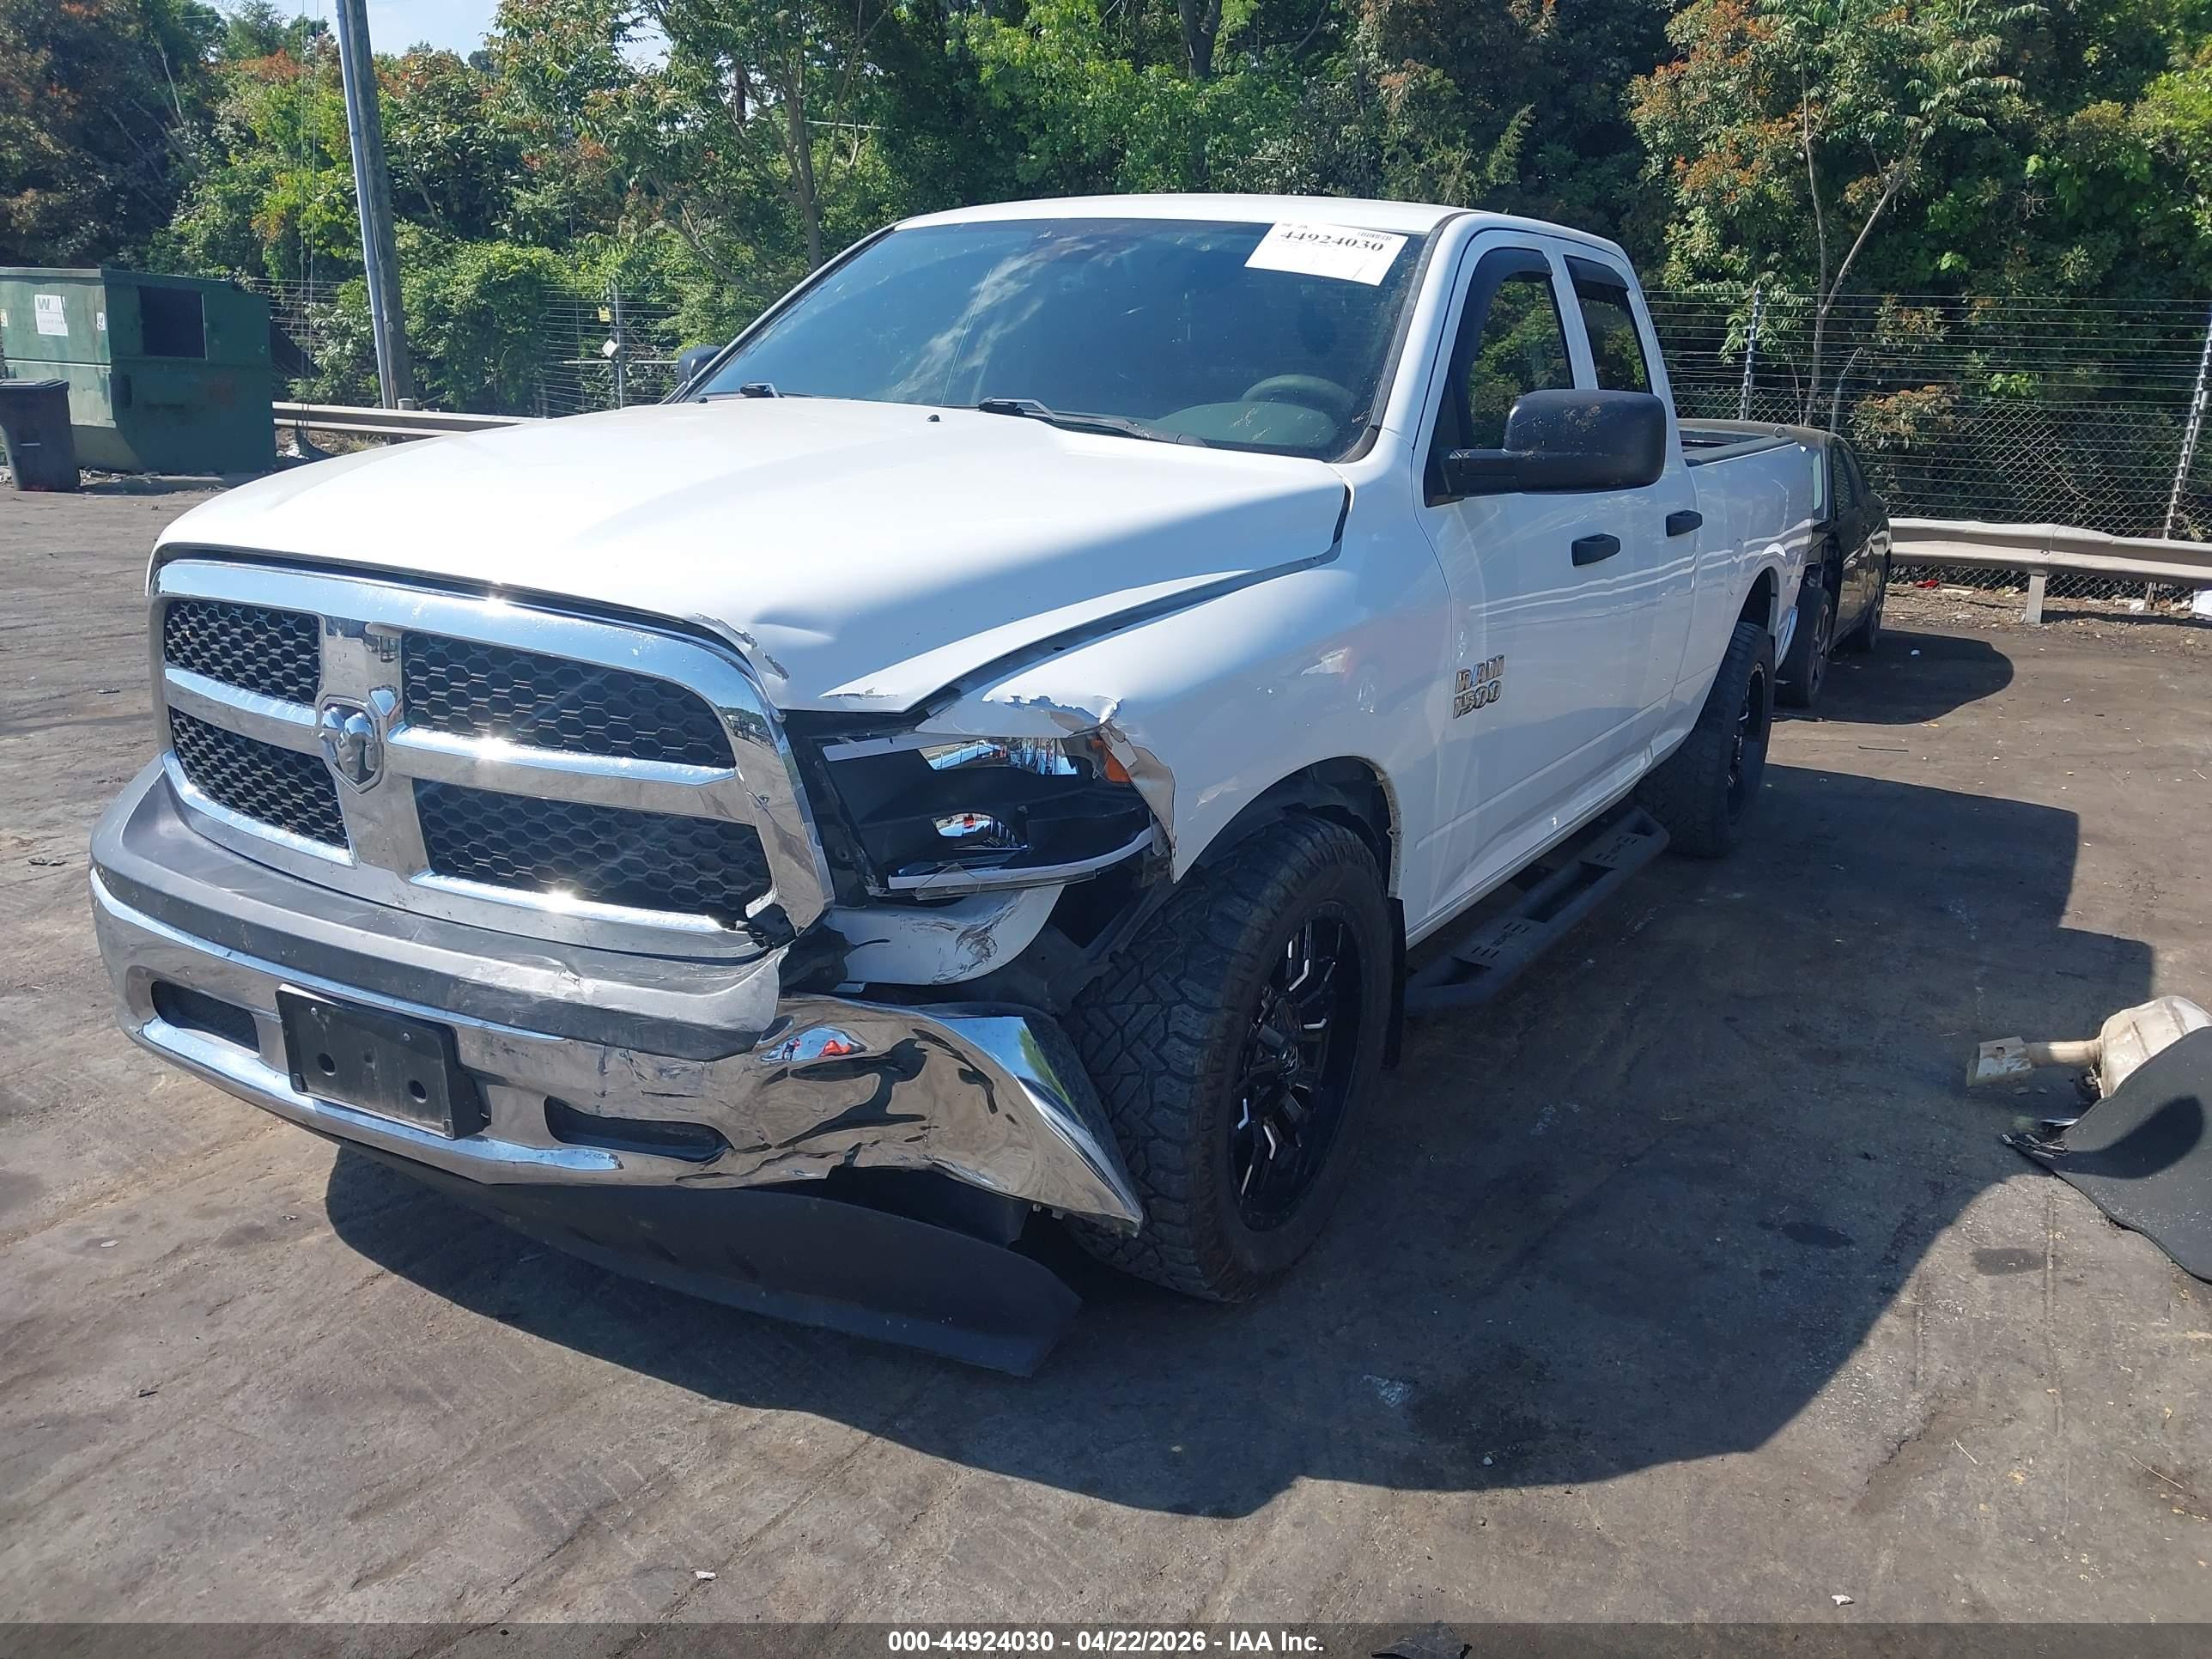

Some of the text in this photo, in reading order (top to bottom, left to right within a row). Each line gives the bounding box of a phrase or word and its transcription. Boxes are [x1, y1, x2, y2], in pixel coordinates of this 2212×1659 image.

[1280, 230, 1384, 252] 44924030
[1455, 653, 1505, 694] RAM
[1453, 680, 1502, 720] 1500
